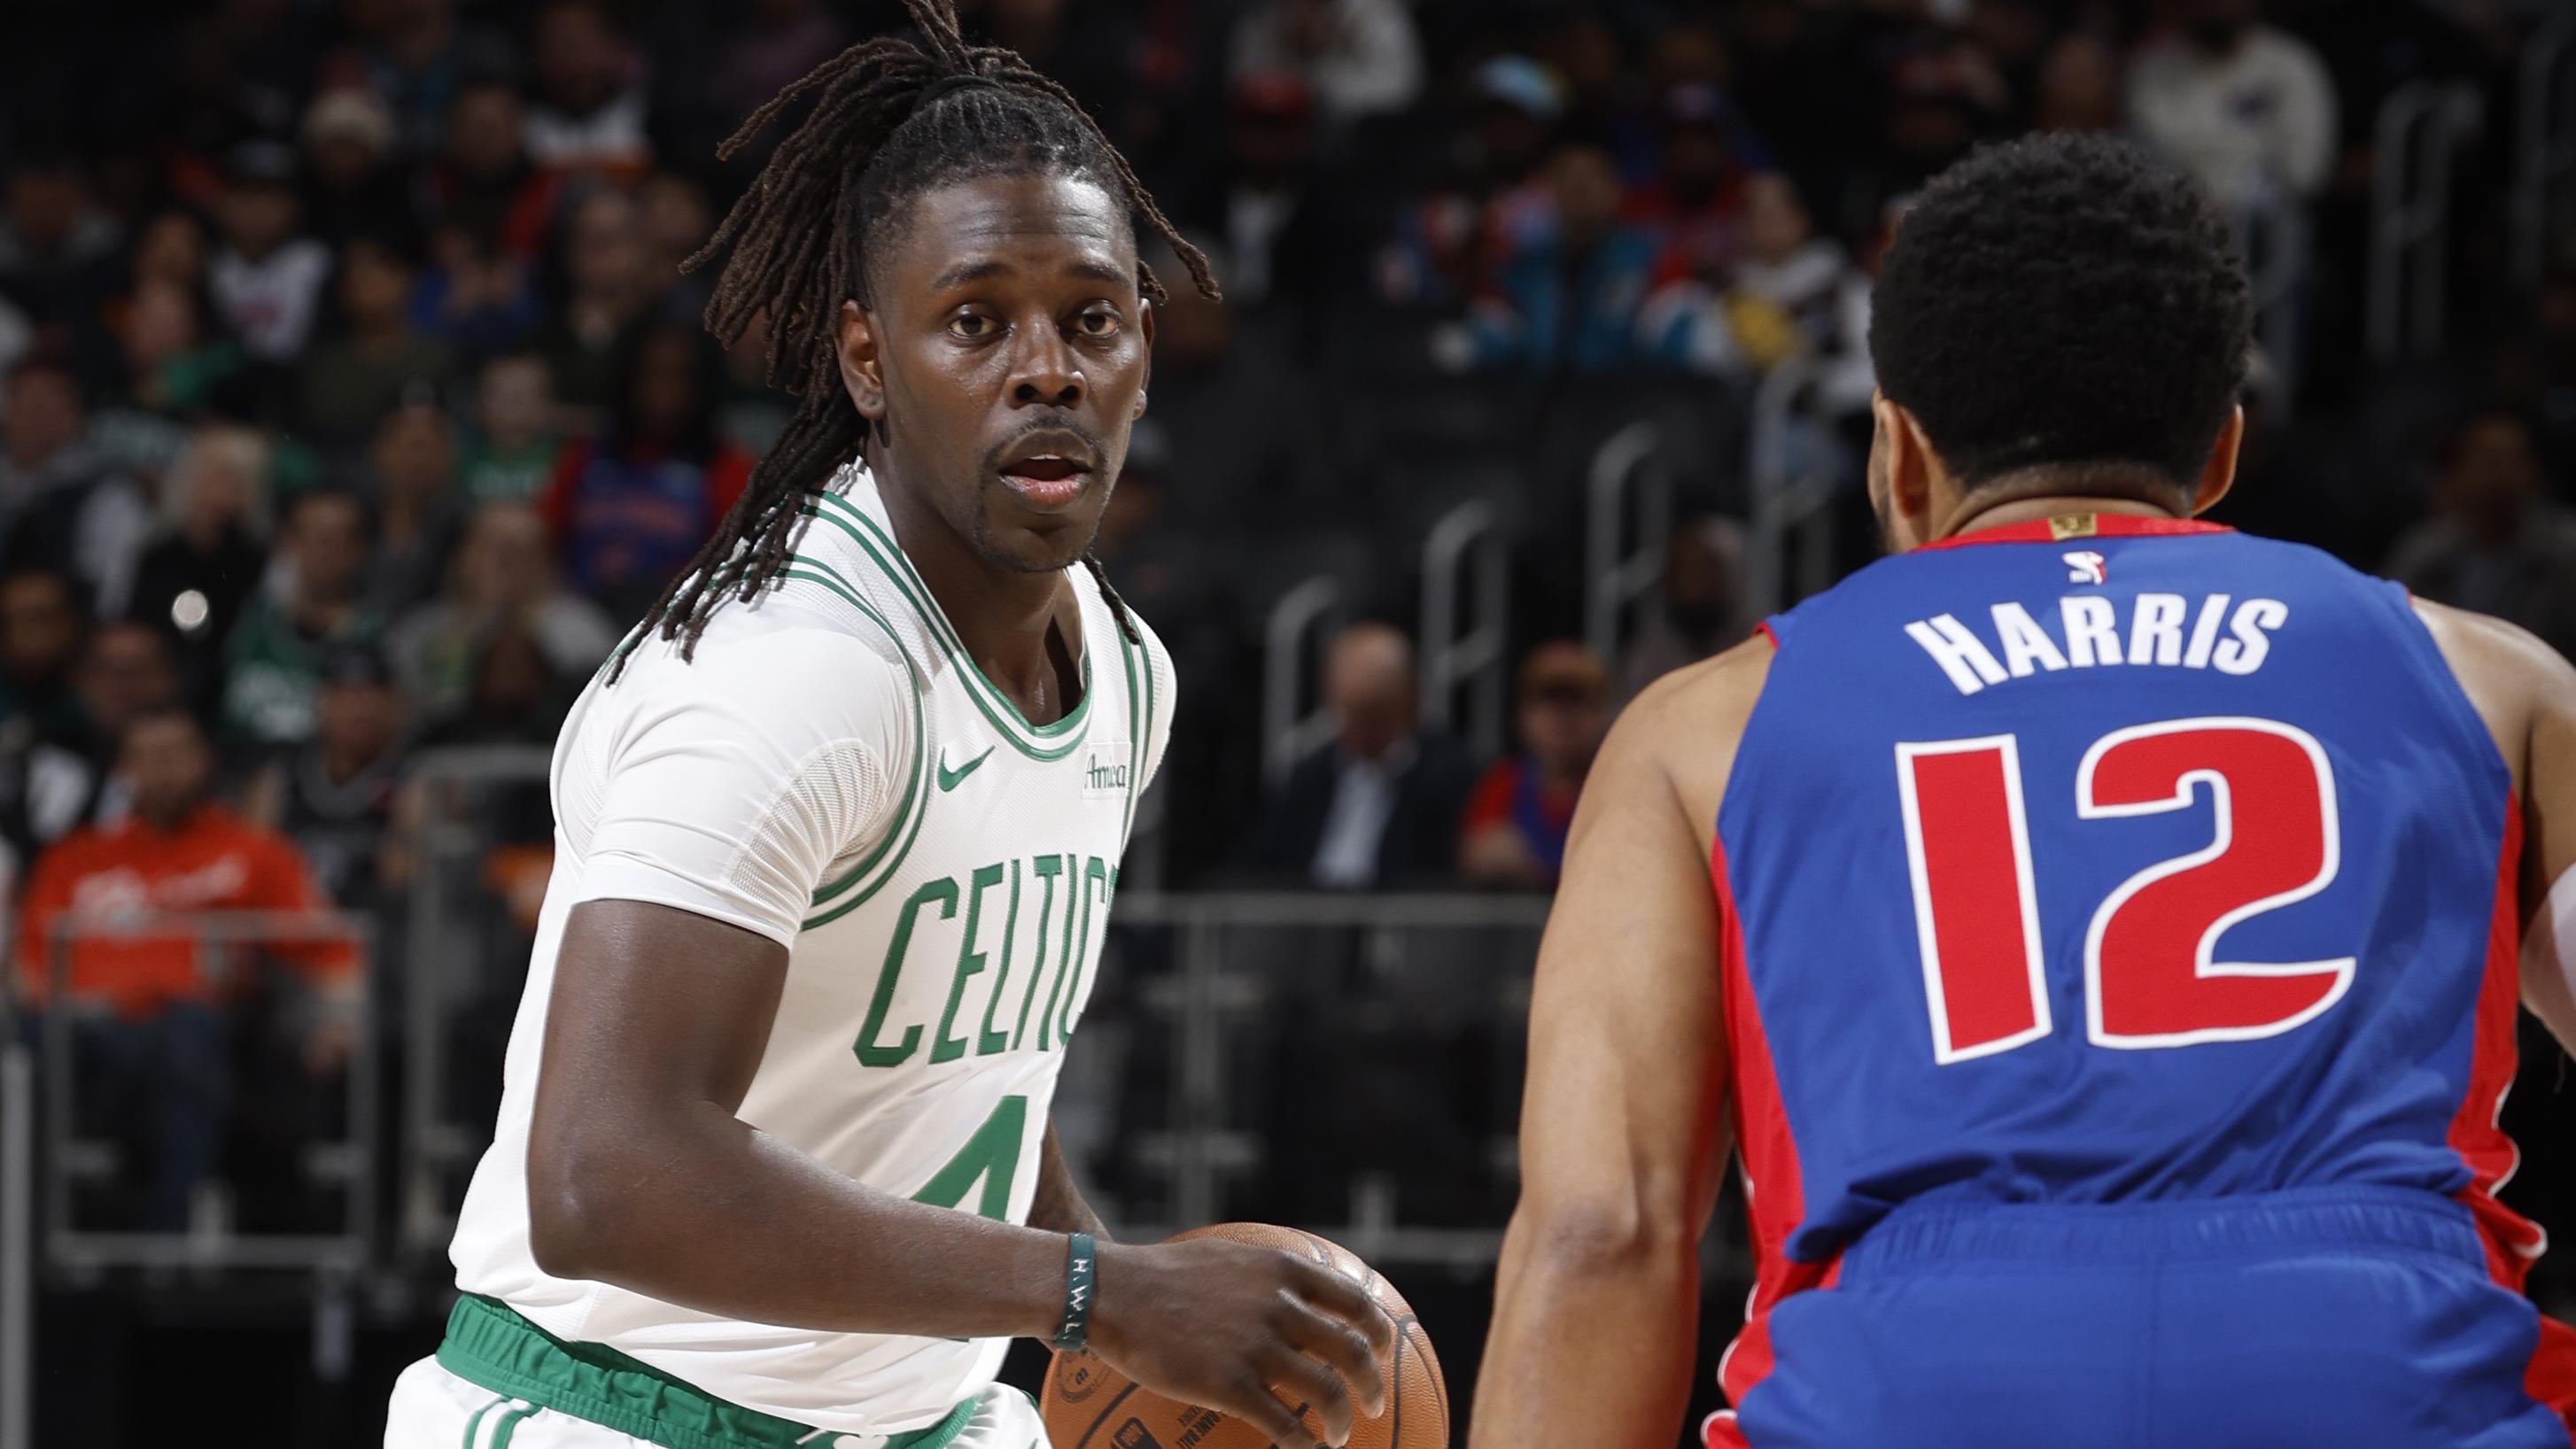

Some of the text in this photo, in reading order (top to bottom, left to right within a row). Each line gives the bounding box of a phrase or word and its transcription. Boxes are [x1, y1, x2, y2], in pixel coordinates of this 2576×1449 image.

[1905, 593, 2288, 695] HARRIS
[852, 854, 1118, 1067] CELTIC
[1895, 716, 2356, 1065] 12
